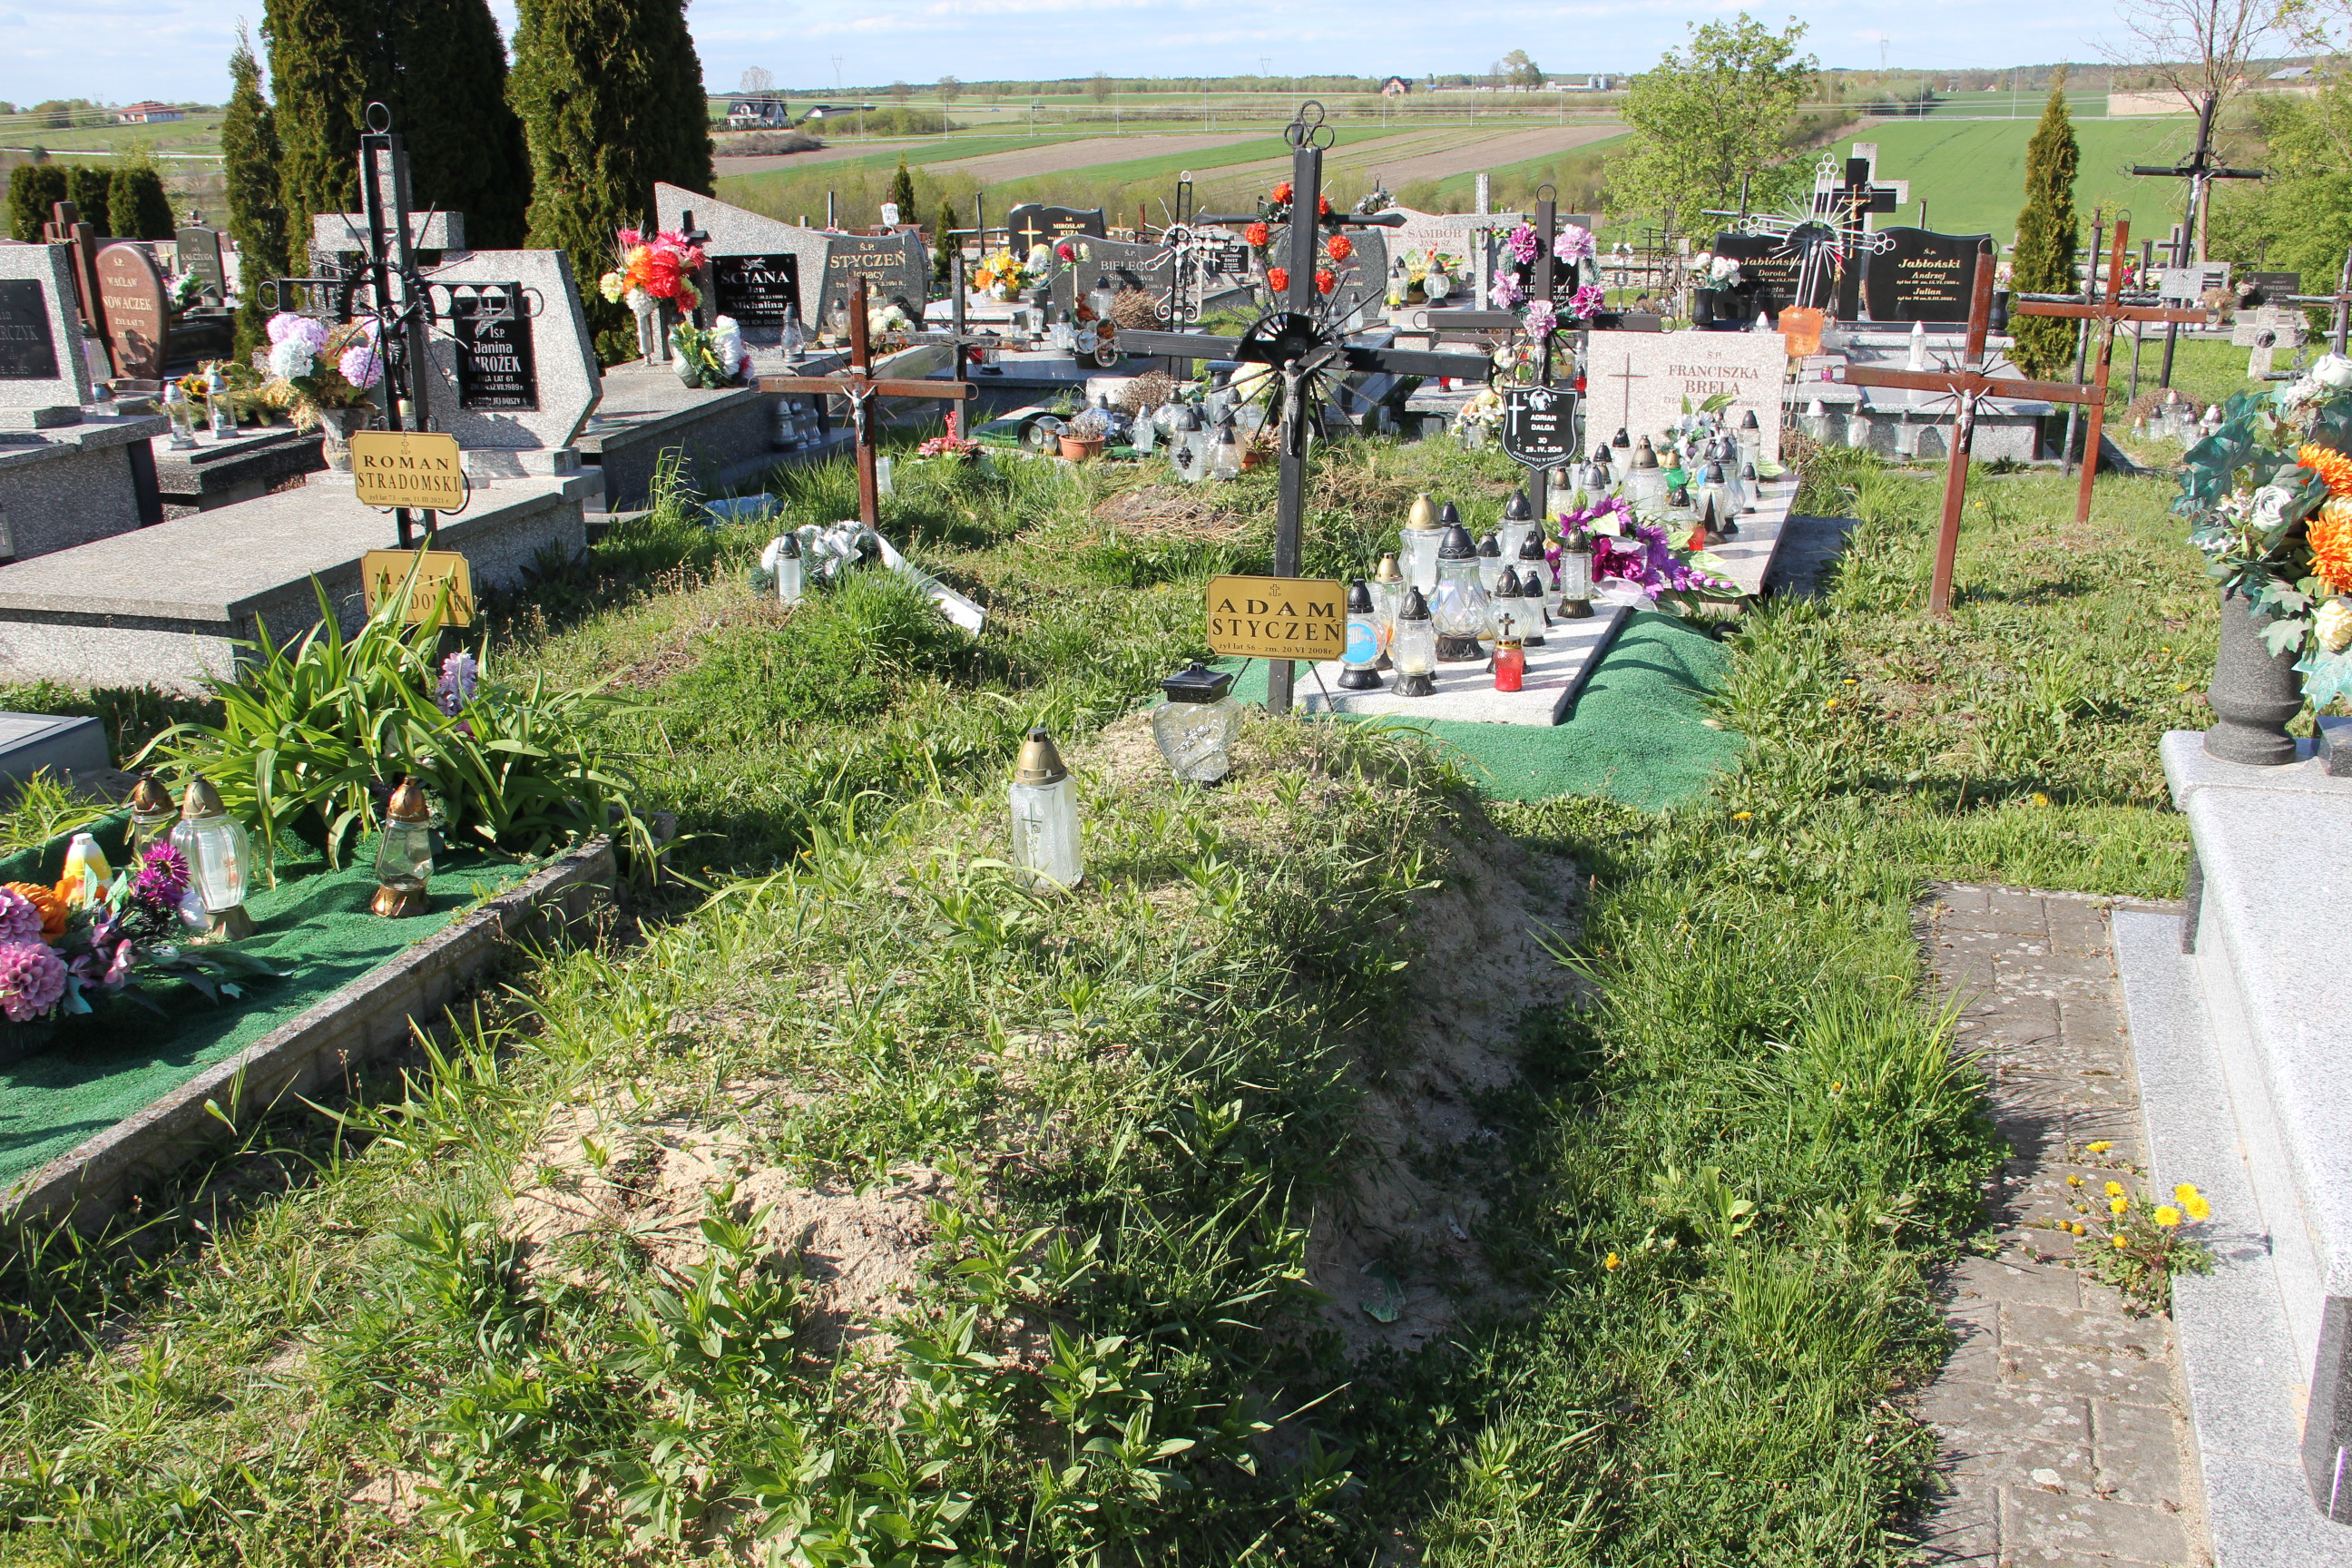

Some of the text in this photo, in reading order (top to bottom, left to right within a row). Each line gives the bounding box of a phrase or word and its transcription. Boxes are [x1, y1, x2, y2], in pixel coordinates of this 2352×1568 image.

[859, 242, 876, 251] Ś.P.
[829, 250, 906, 268] STYCZEŃ
[1897, 258, 1961, 269] Jabłoński
[720, 269, 790, 284] ŚCIANA
[853, 270, 885, 280] Ignacy
[1758, 269, 1787, 277] Dorota
[1911, 271, 1946, 280] Andrzej
[1912, 287, 1941, 295] Julian
[103, 295, 152, 311] NOWACZEK
[473, 341, 514, 354] Janina
[468, 354, 522, 372] MROŻEK
[1669, 365, 1759, 378] FRANCISZKA
[1685, 380, 1740, 395] BRELA
[363, 455, 450, 470] ROMAN
[1513, 451, 1541, 462] SPOCZYWAJ
[358, 472, 459, 493] STRADOMSKI
[369, 494, 378, 502] żył
[369, 591, 469, 612] SDOKI
[1216, 598, 1336, 618] ADAM
[1212, 618, 1341, 642] STYCZEŃ
[1218, 642, 1230, 650] żył
